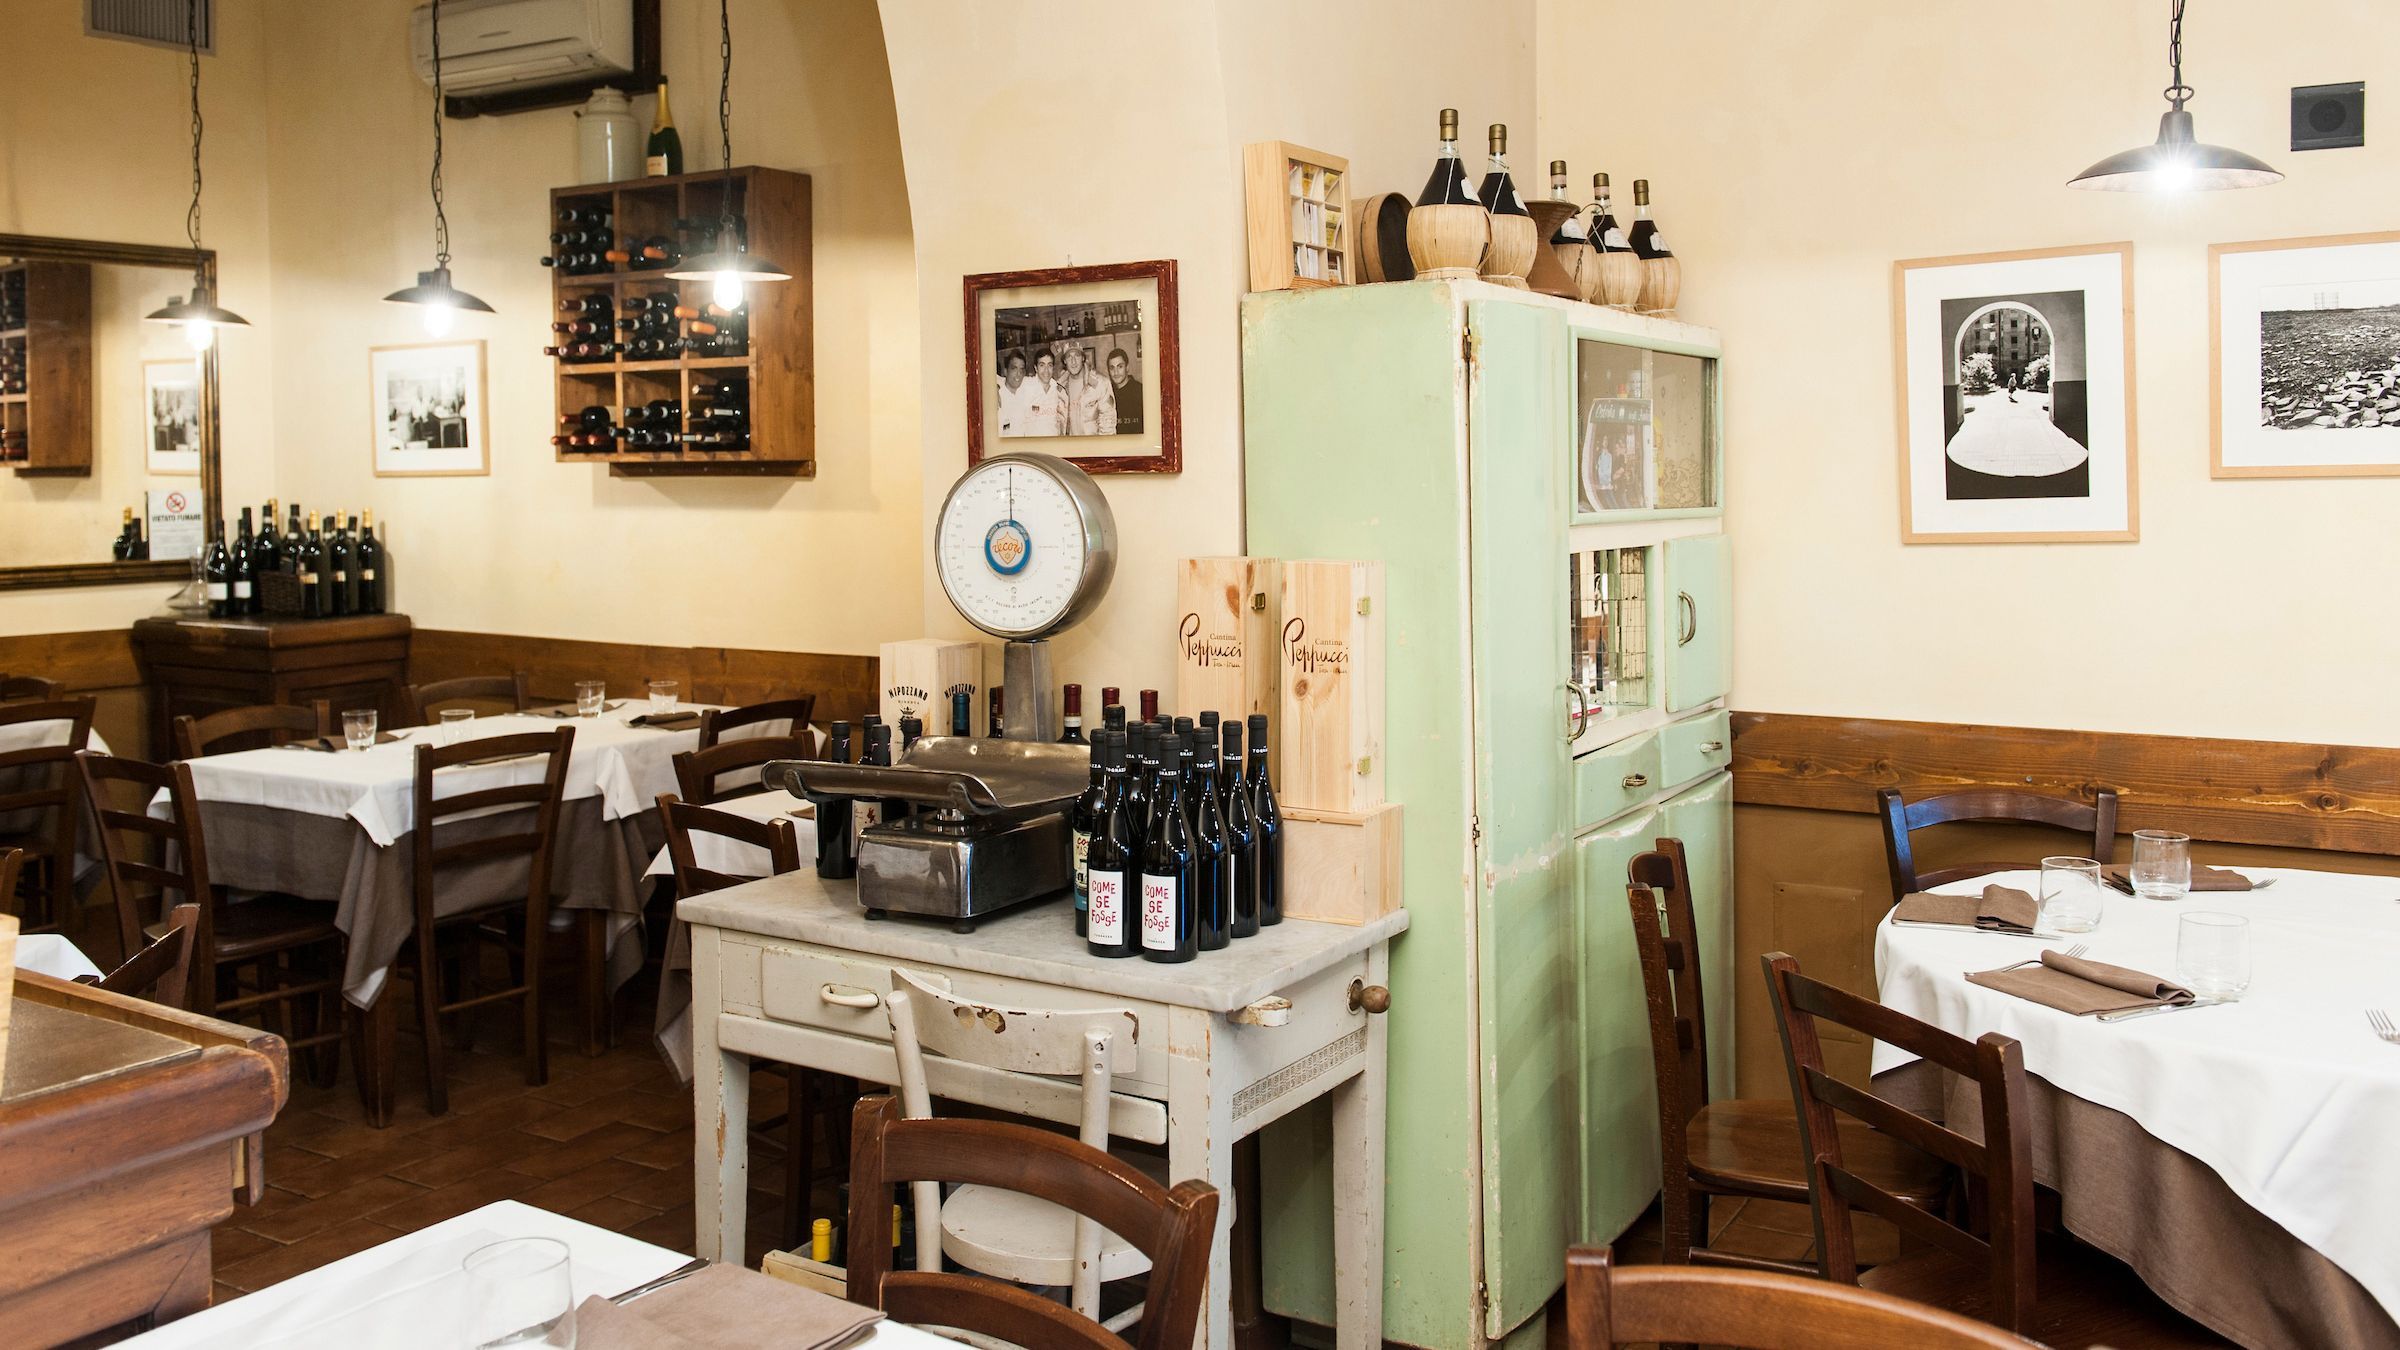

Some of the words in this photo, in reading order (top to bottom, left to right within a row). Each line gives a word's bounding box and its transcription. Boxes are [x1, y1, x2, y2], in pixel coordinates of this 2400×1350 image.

[1179, 612, 1242, 667] Peppucci
[1209, 633, 1236, 641] Cantina
[1314, 638, 1343, 646] Cantina
[1282, 617, 1349, 673] Peppucci
[888, 686, 928, 701] NIPOZZANO
[1091, 880, 1116, 894] COME
[1145, 884, 1169, 899] COME
[1095, 895, 1110, 908] SE
[1148, 900, 1163, 913] SE
[1091, 909, 1117, 927] FOSSE
[1144, 914, 1170, 932] FOSSE
